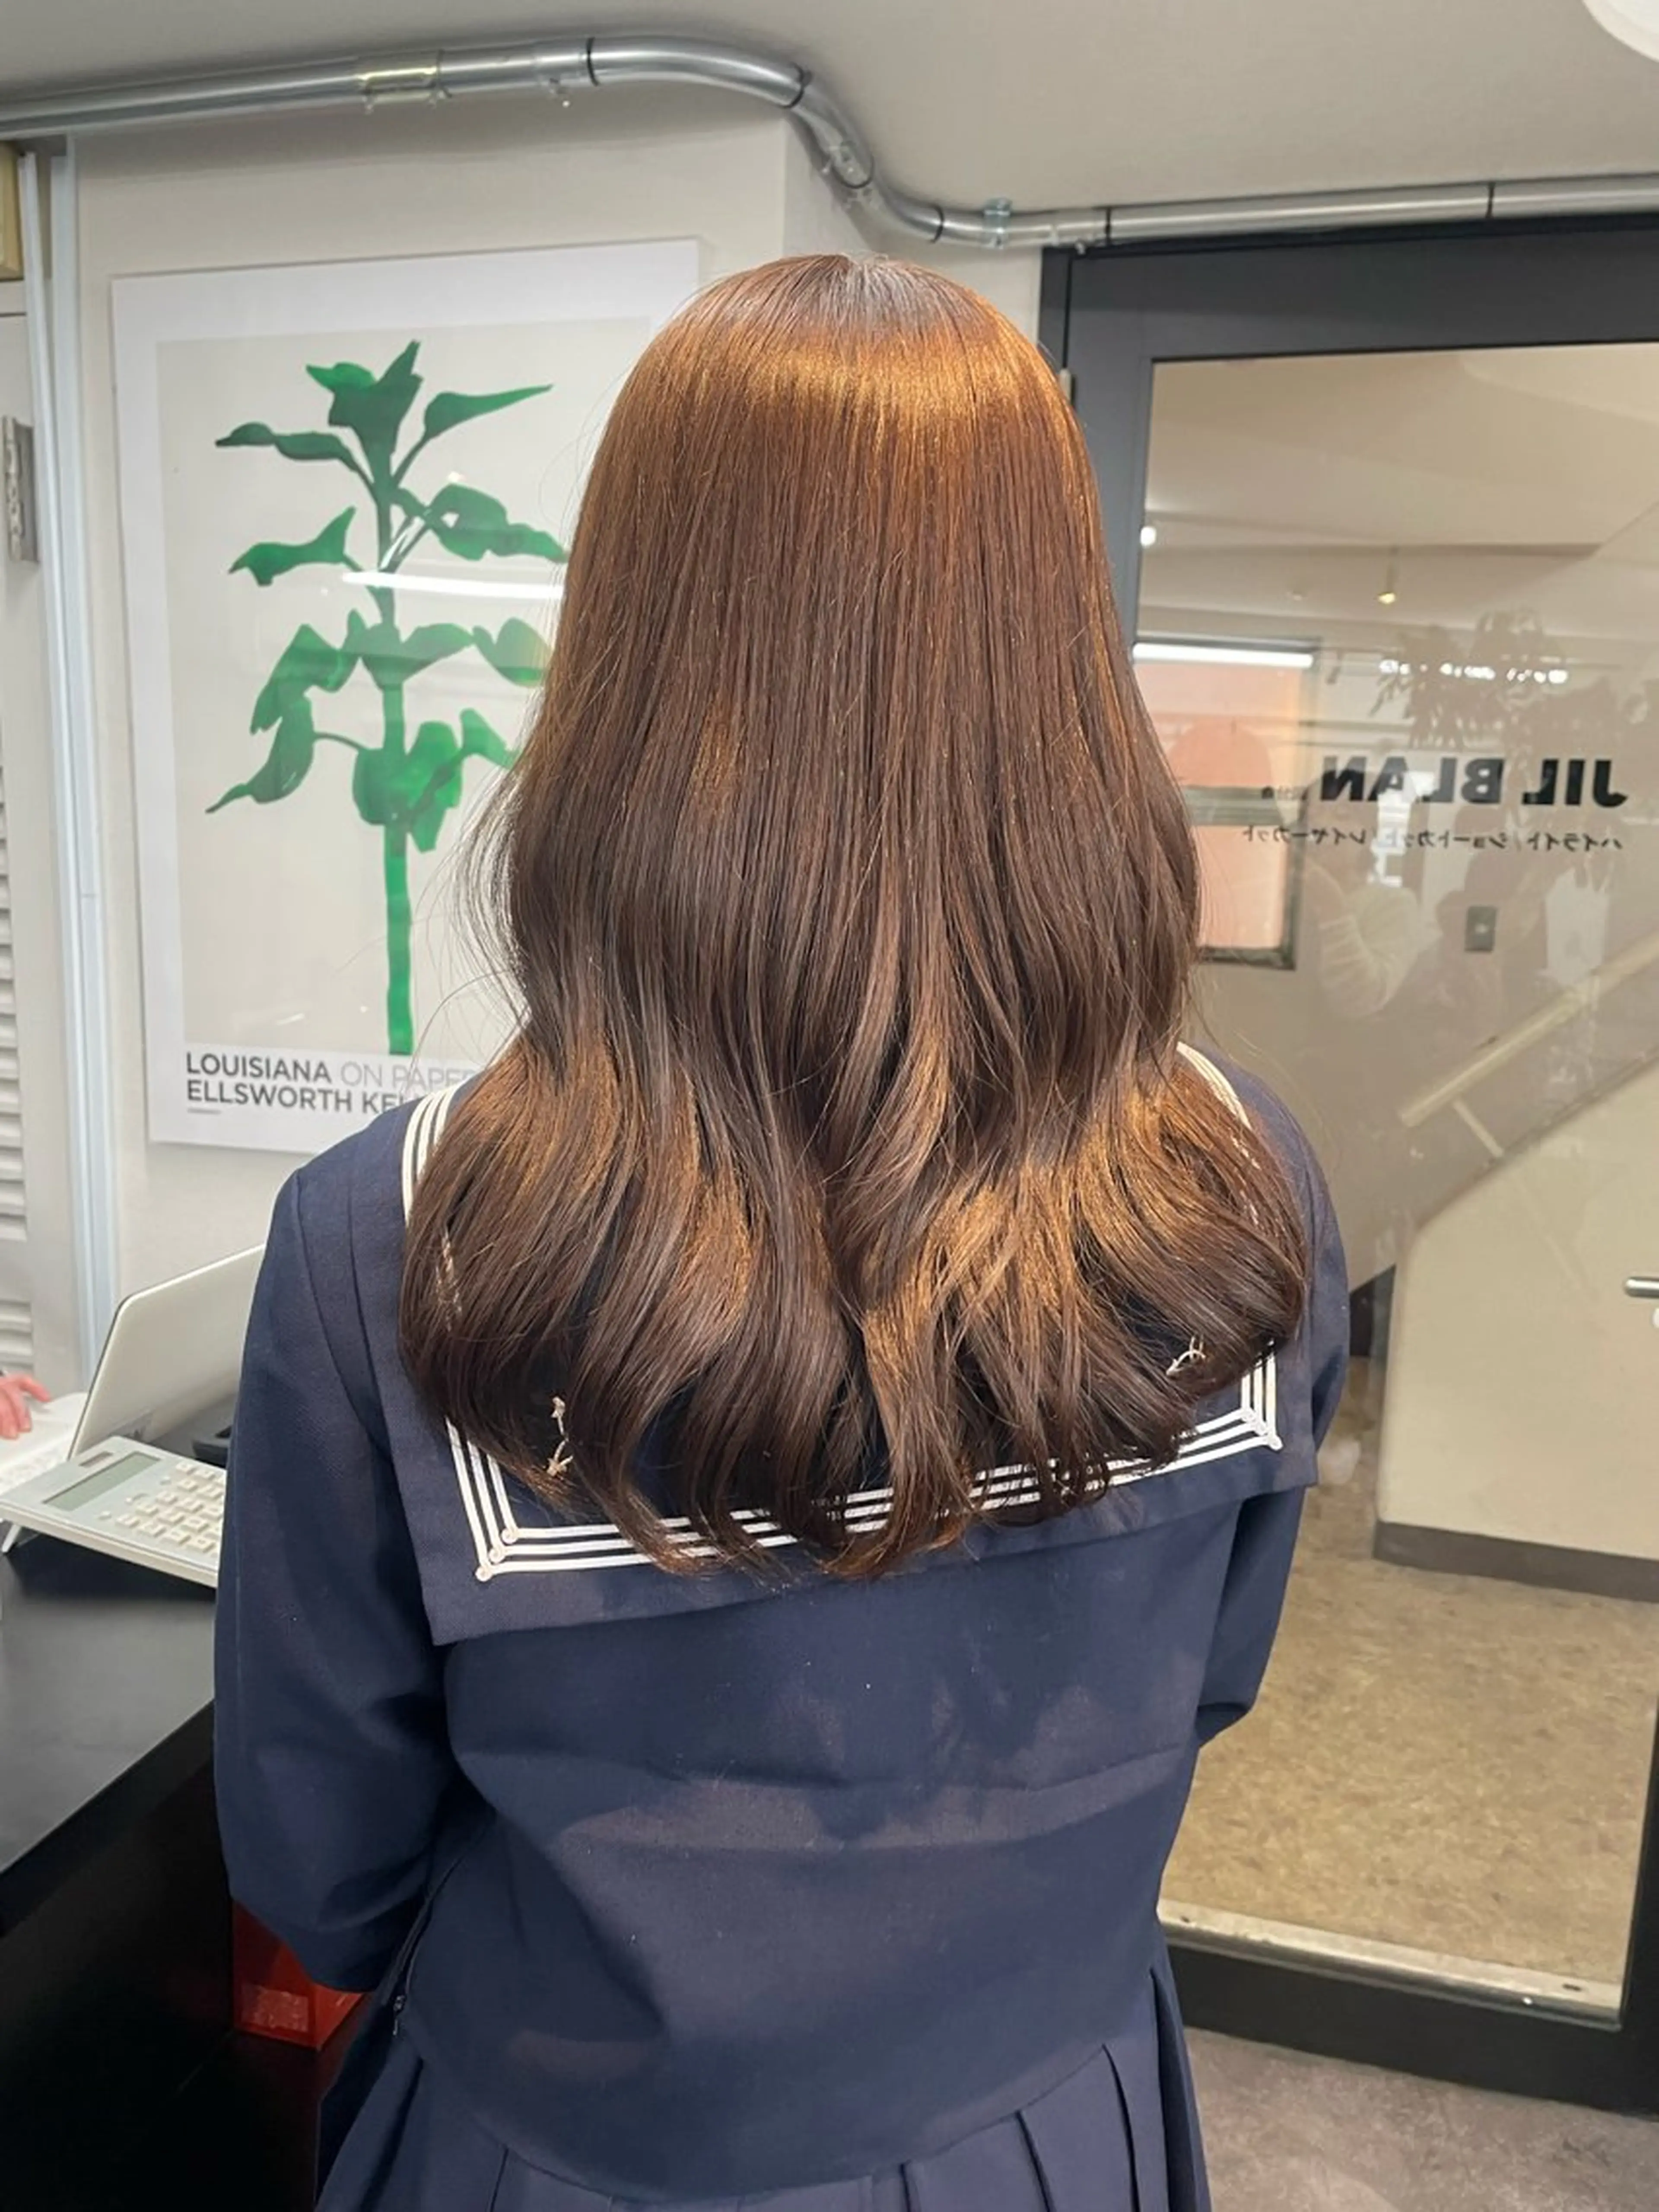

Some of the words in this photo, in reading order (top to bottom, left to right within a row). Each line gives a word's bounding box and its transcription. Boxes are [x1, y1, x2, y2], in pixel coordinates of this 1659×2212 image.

[187, 1052, 332, 1084] LOUISIANA
[340, 1062, 382, 1087] ON
[188, 1080, 351, 1112] ELLSWORTH
